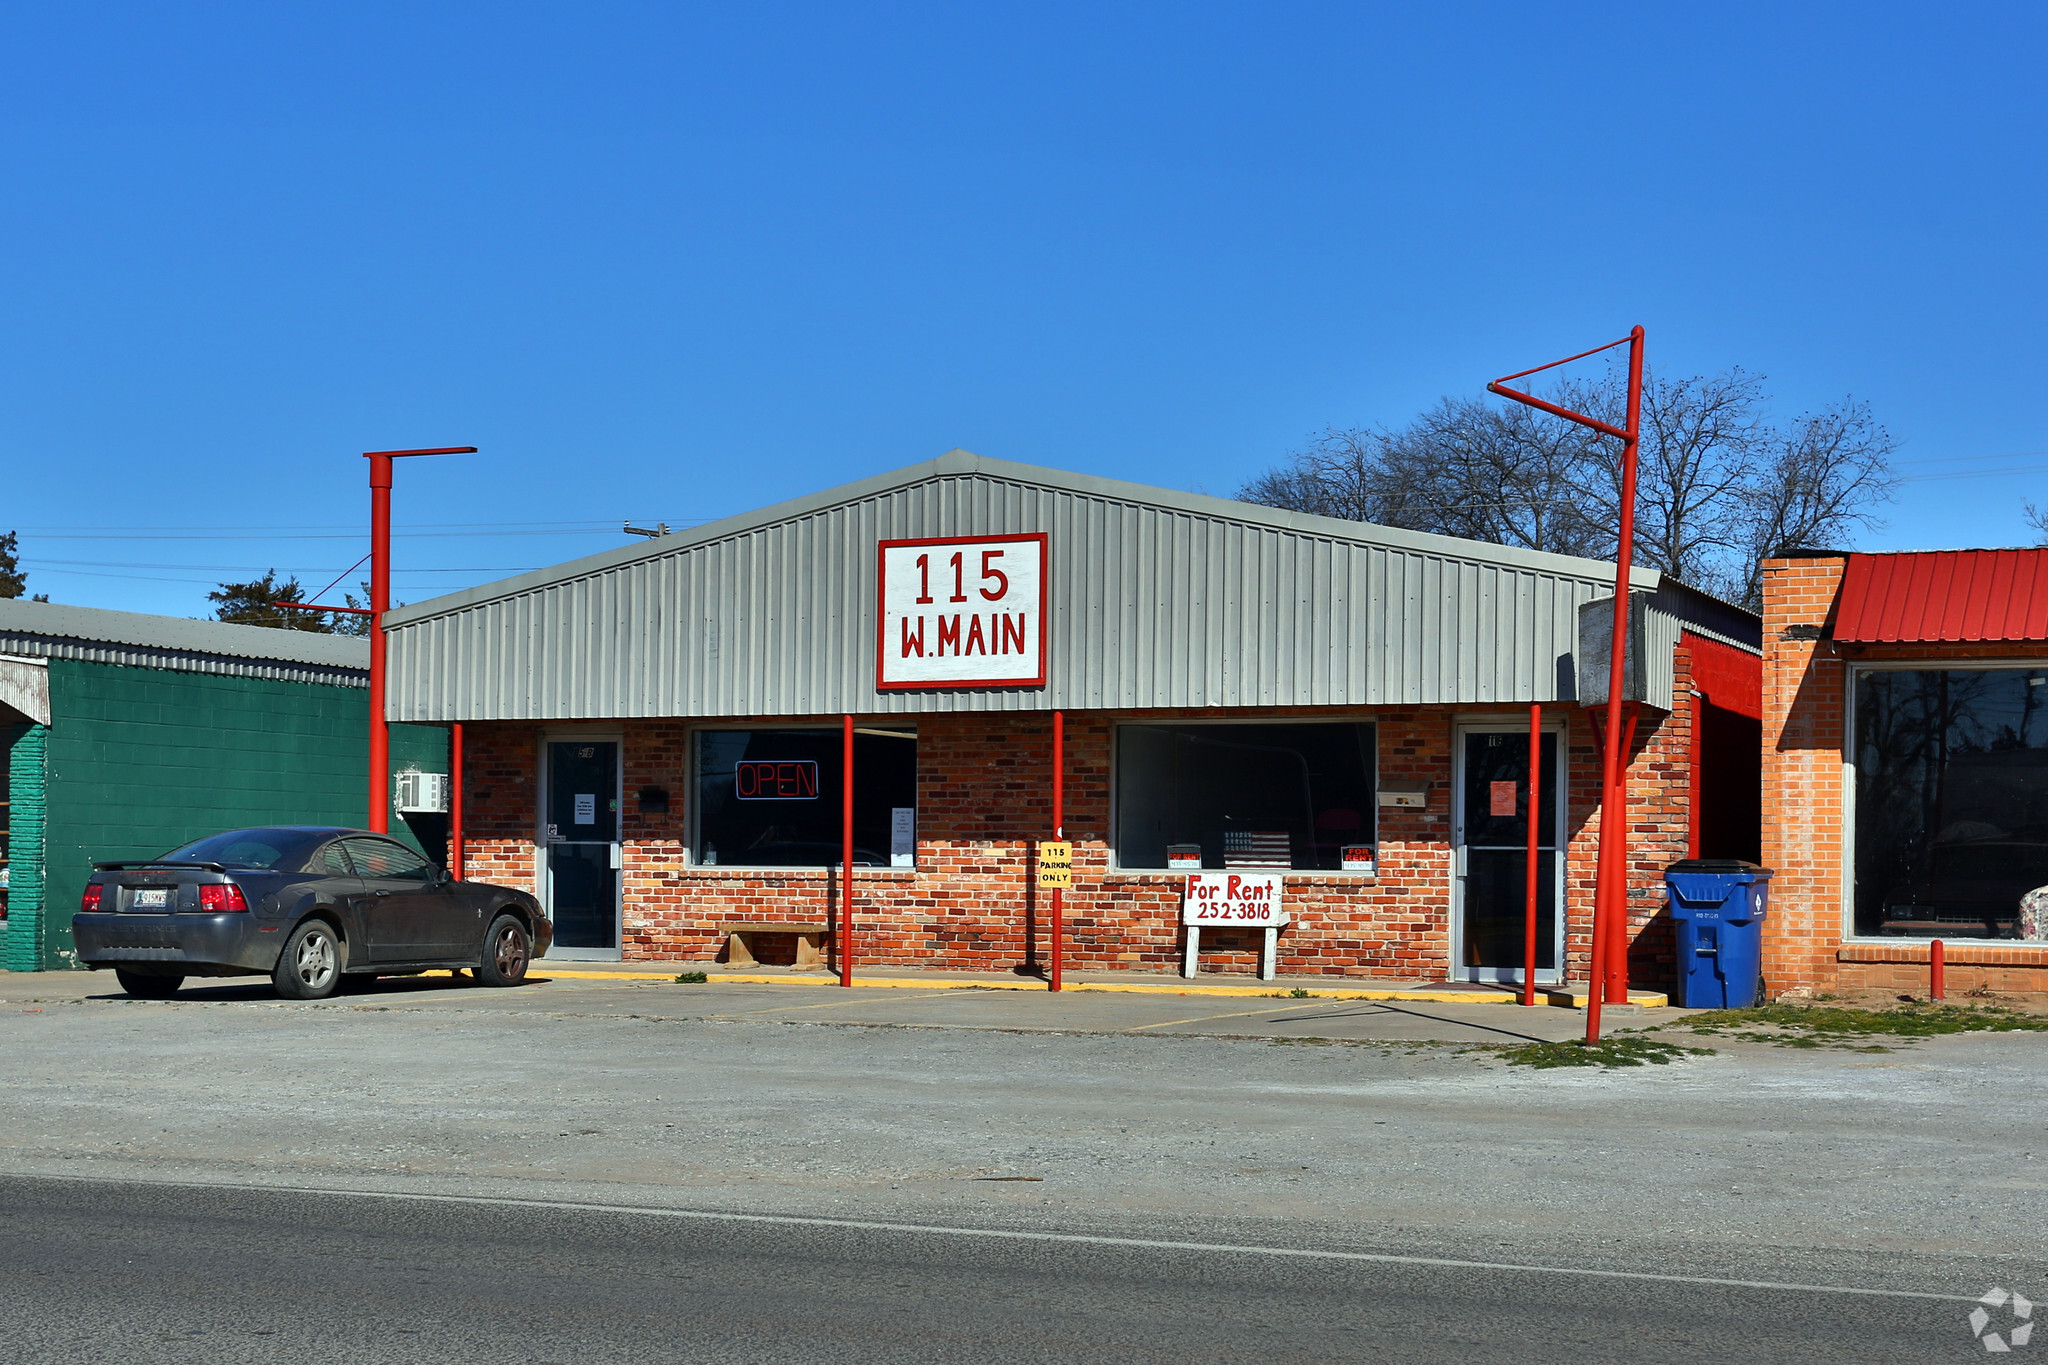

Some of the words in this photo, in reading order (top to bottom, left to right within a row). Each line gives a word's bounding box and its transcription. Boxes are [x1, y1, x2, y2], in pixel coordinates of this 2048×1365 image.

[916, 550, 1009, 605] 115
[901, 613, 1026, 659] W.MAIN
[738, 764, 815, 796] OPEN
[1047, 848, 1065, 857] 115
[1042, 874, 1068, 882] ONLY
[1187, 875, 1220, 899] For
[1227, 875, 1273, 900] Rent
[1197, 902, 1270, 919] 252-3818
